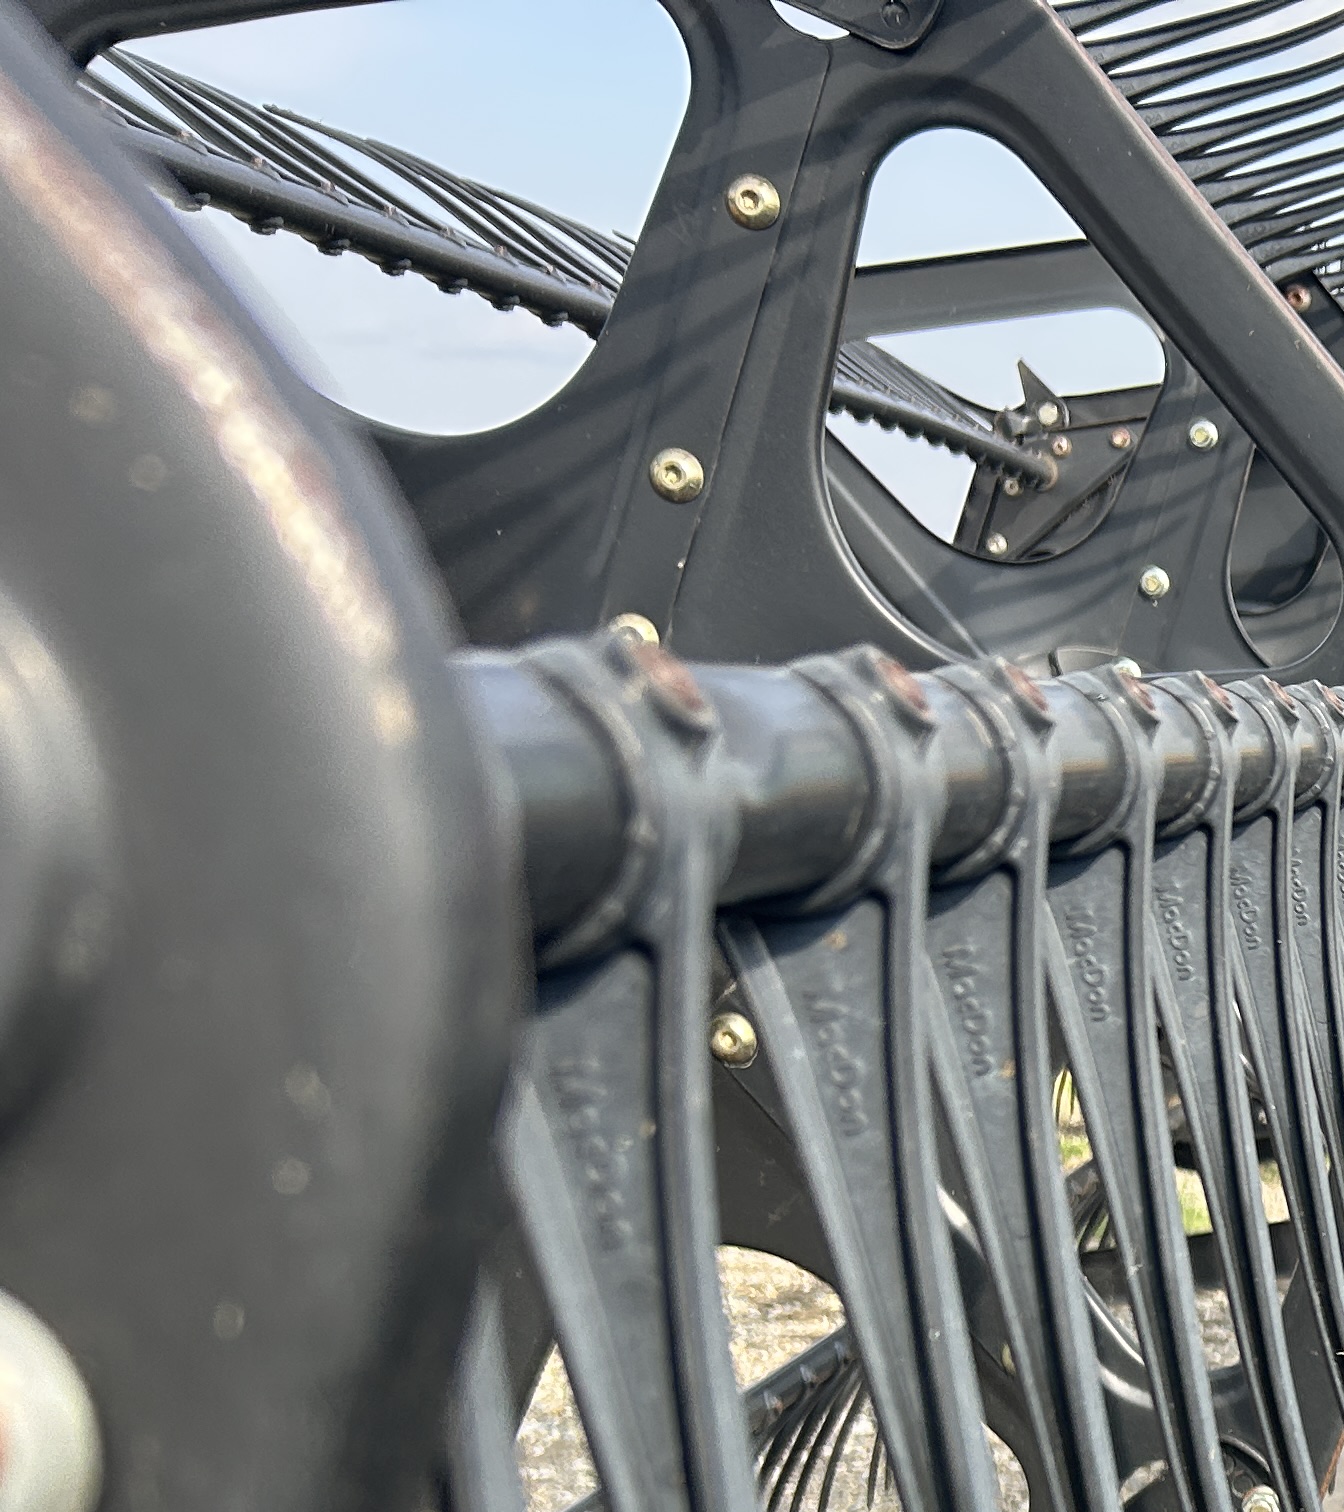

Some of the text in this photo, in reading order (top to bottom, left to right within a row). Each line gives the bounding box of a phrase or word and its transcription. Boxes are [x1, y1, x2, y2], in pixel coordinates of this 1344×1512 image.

[1154, 879, 1197, 982] MacDon
[1229, 866, 1263, 951] MacDon
[941, 942, 997, 1078] MacDon
[1063, 906, 1113, 1023] MacDon
